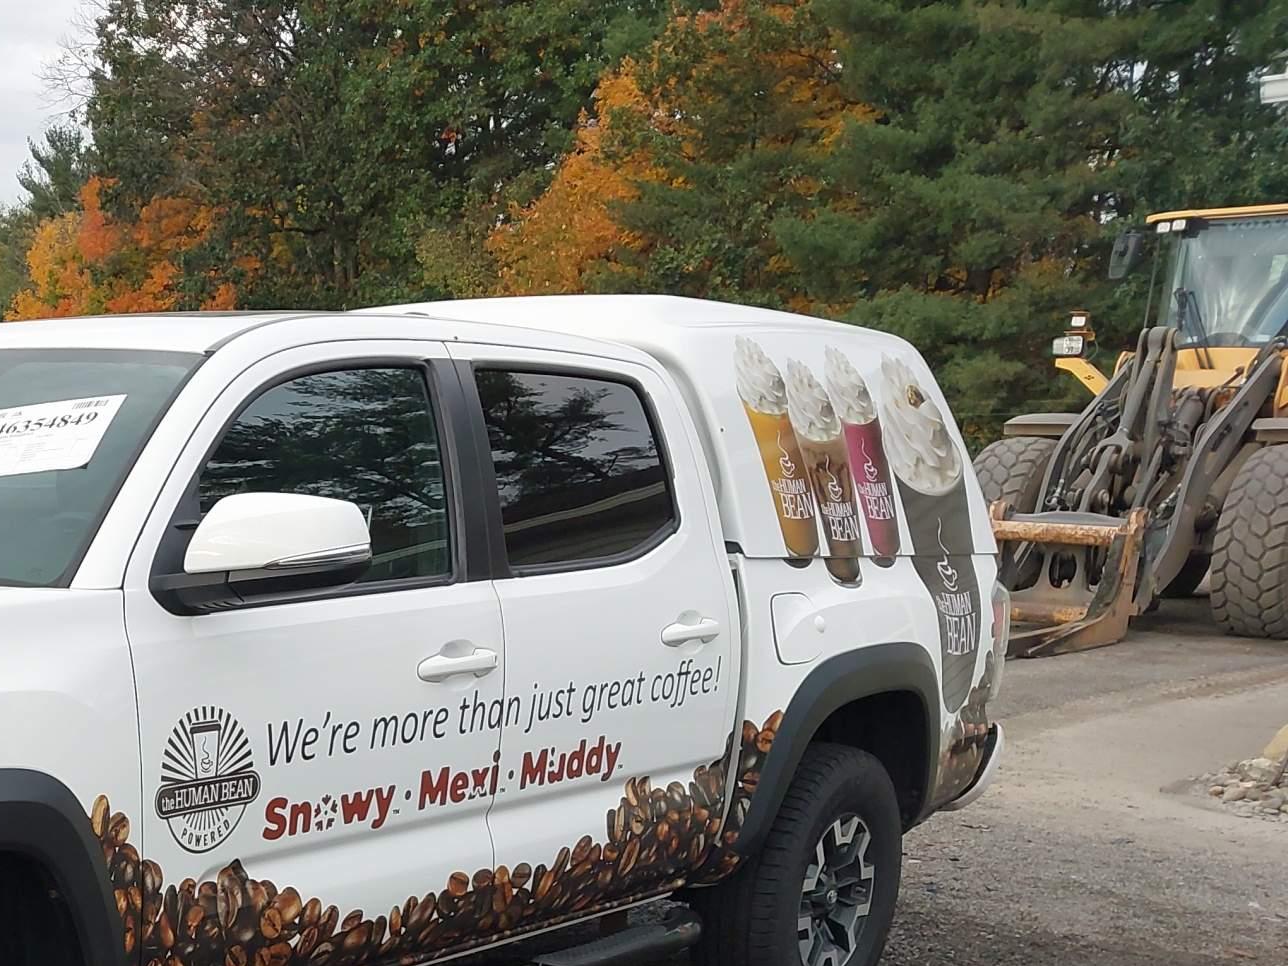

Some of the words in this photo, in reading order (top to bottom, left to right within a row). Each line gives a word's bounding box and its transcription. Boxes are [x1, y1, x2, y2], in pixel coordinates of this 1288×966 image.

[779, 492, 814, 519] BEAN
[865, 495, 895, 520] BEAN
[828, 515, 860, 541] BEAN
[944, 612, 976, 655] BEAN
[267, 711, 360, 766] We're
[370, 707, 449, 750] more
[459, 690, 521, 734] than
[524, 681, 576, 733] just
[581, 671, 646, 723] great
[650, 655, 722, 708] coffee!
[519, 735, 622, 790] Muddy
[222, 778, 254, 803] BEAN
[181, 818, 231, 847] POWERED
